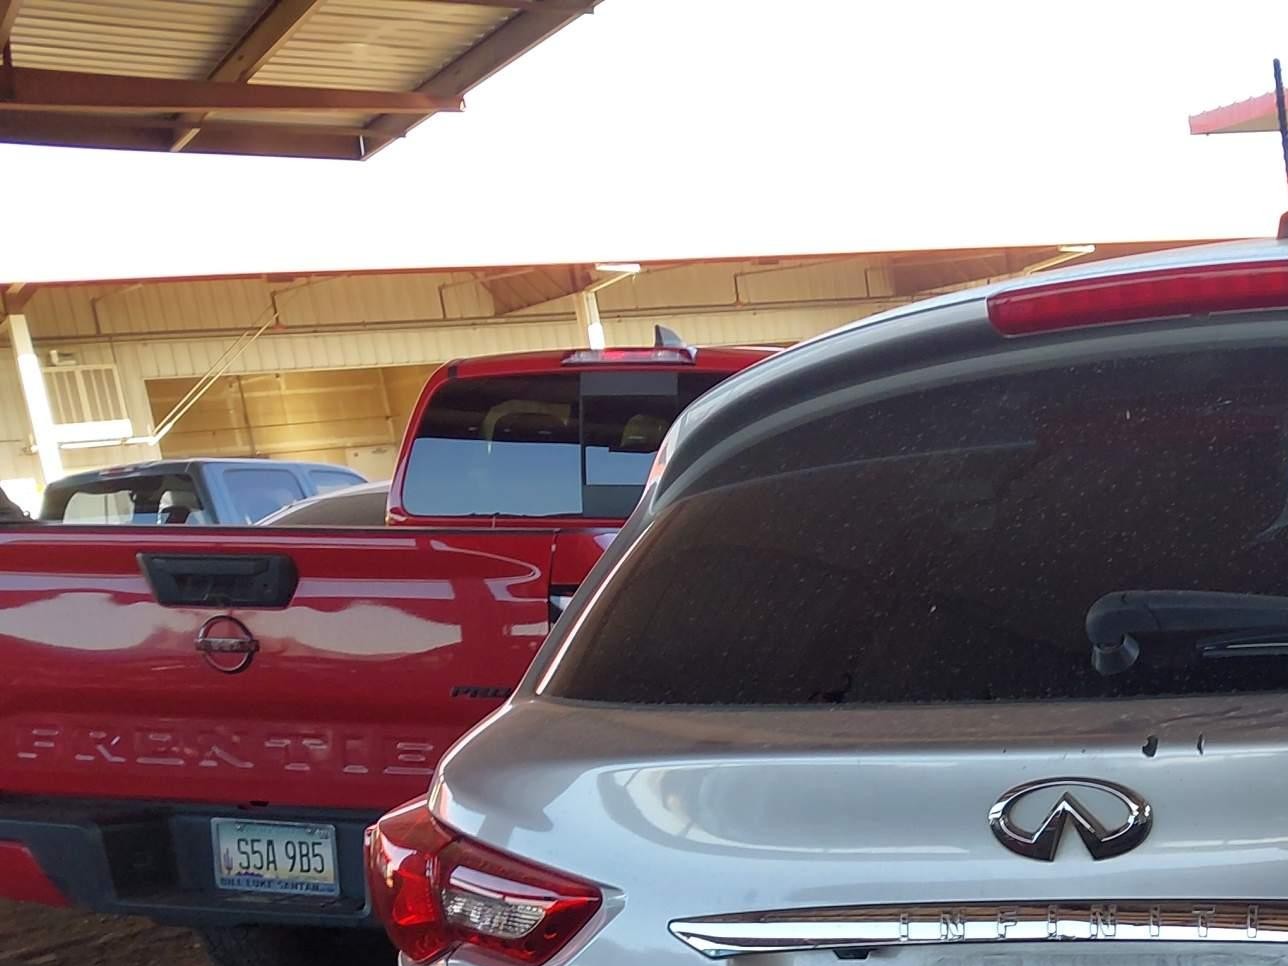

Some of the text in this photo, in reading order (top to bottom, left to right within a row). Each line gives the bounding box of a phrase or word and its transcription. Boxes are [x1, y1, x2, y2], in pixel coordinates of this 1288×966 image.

[237, 838, 325, 873] S5A 9B5
[899, 903, 1258, 940] INFINITI
